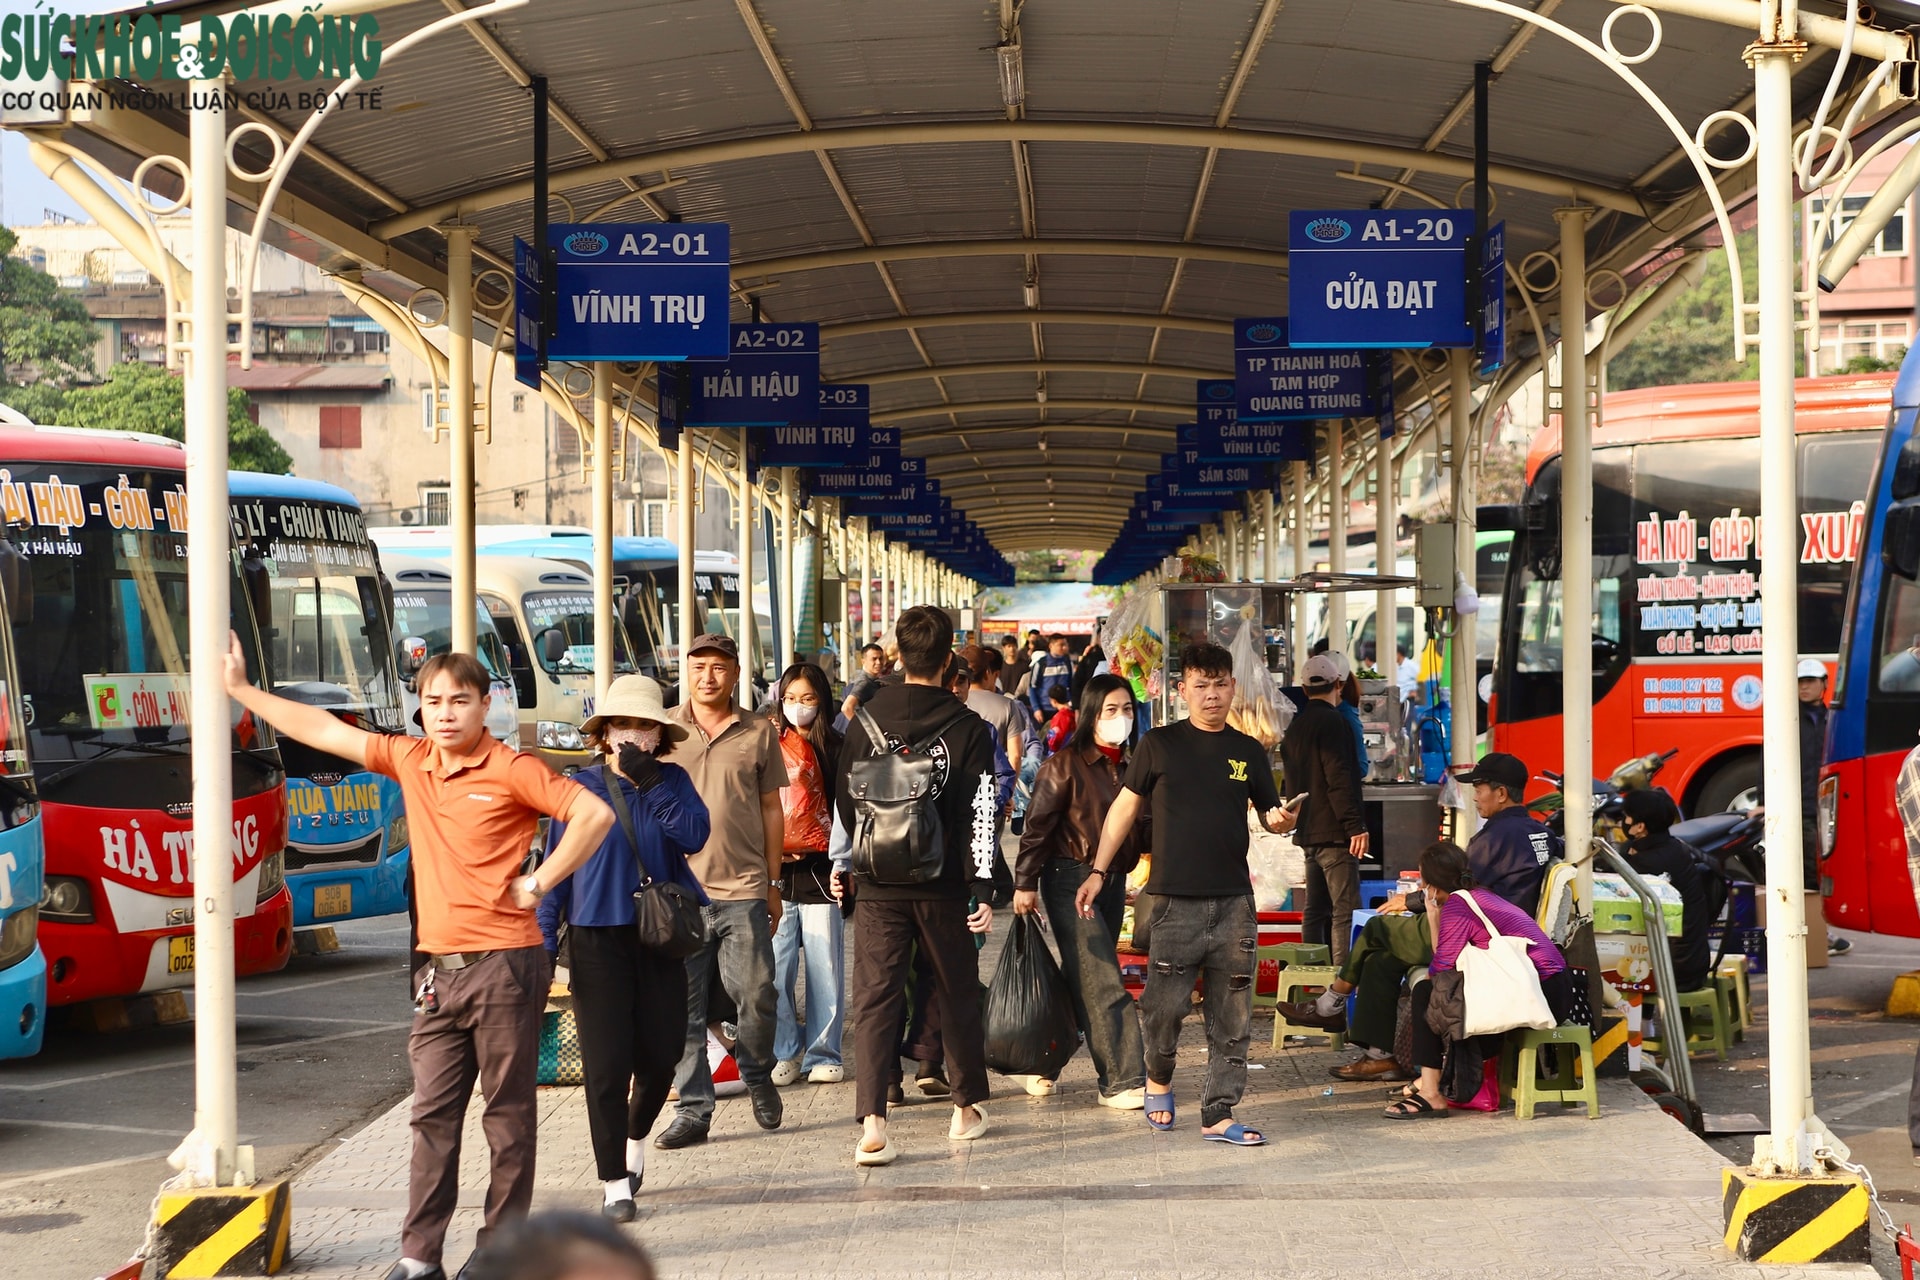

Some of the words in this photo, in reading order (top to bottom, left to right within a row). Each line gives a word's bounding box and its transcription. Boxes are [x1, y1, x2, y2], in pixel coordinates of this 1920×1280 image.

[1361, 218, 1453, 241] A1-20
[619, 233, 709, 256] A2-01
[1326, 272, 1379, 310] CỬA
[1386, 281, 1437, 315] ĐẠT
[572, 290, 640, 324] VĨNH
[650, 295, 706, 329] TRỤ
[735, 331, 805, 348] A2-02
[1247, 358, 1267, 372] TP
[1271, 356, 1324, 371] THANH
[703, 370, 742, 398] HẢI
[751, 372, 799, 402] HẬU
[1270, 376, 1303, 391] TAM
[1308, 374, 1340, 392] HỢP
[819, 390, 857, 404] 2-03
[1250, 396, 1304, 412] QUANG
[1308, 394, 1361, 409] TRUNG
[1207, 408, 1222, 420] TP
[822, 427, 855, 448] TRỤ
[819, 474, 856, 489] THỊNH
[860, 474, 892, 486] LONG
[30, 474, 86, 536] HẬU
[104, 474, 154, 530] CỒN
[245, 498, 266, 536] LÝ
[279, 501, 328, 540] CHÙA
[327, 506, 366, 544] VÀNG
[58, 539, 82, 557] HẬU
[1637, 511, 1662, 564] HÀ
[1664, 510, 1697, 572] NỘI
[1710, 508, 1754, 562] GIÁP
[1660, 678, 1683, 693] 0988
[1684, 678, 1703, 693] 827
[1684, 697, 1703, 713] 827
[311, 773, 341, 783] SAMCO
[330, 778, 380, 812] VÀNG
[99, 819, 158, 881] HÀ
